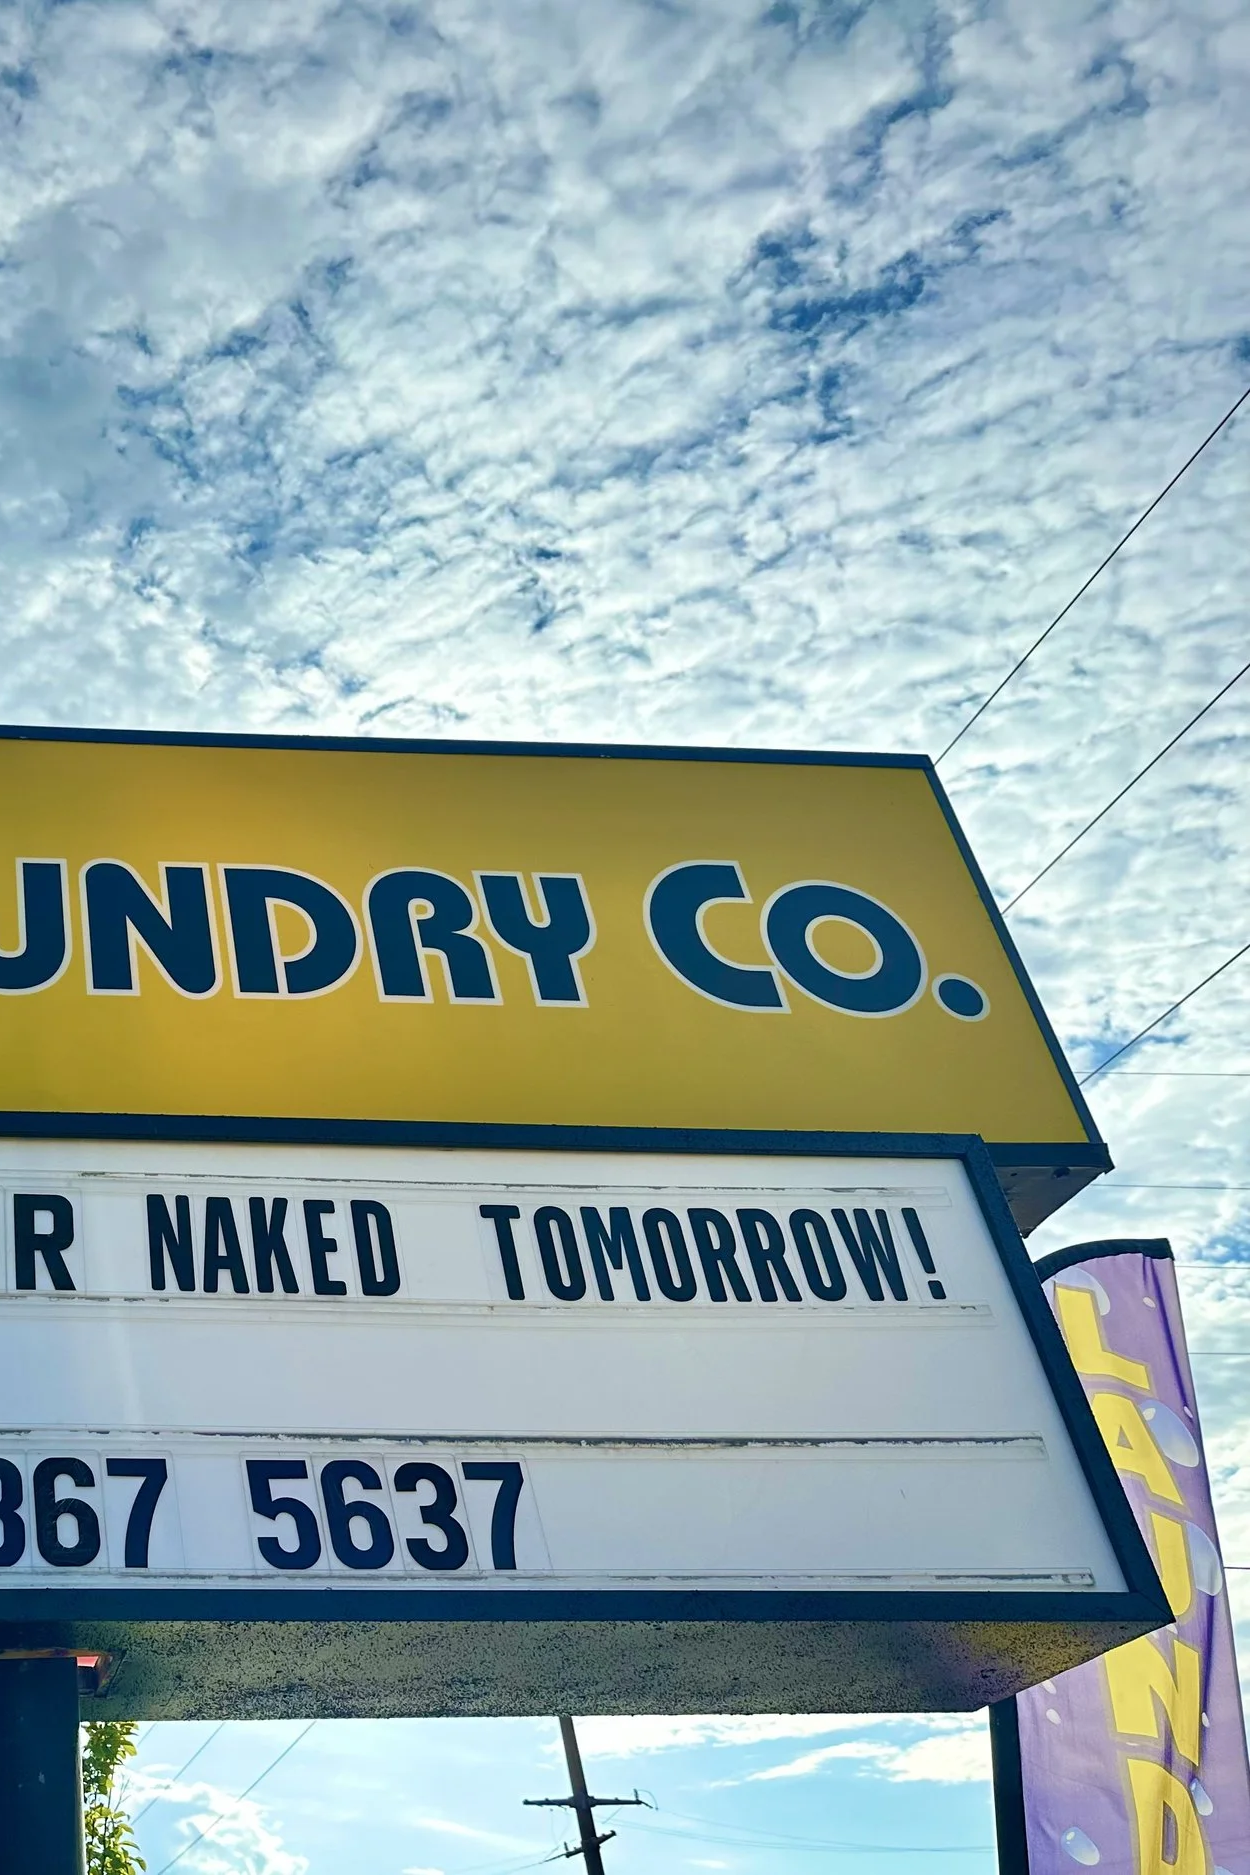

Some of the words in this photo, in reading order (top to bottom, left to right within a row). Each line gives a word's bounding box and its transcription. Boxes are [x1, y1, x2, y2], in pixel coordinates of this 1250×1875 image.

[643, 860, 991, 1021] CO.
[147, 1195, 401, 1297] NAKED
[480, 1205, 947, 1302] TOMORROW!
[245, 1459, 525, 1571] 5637
